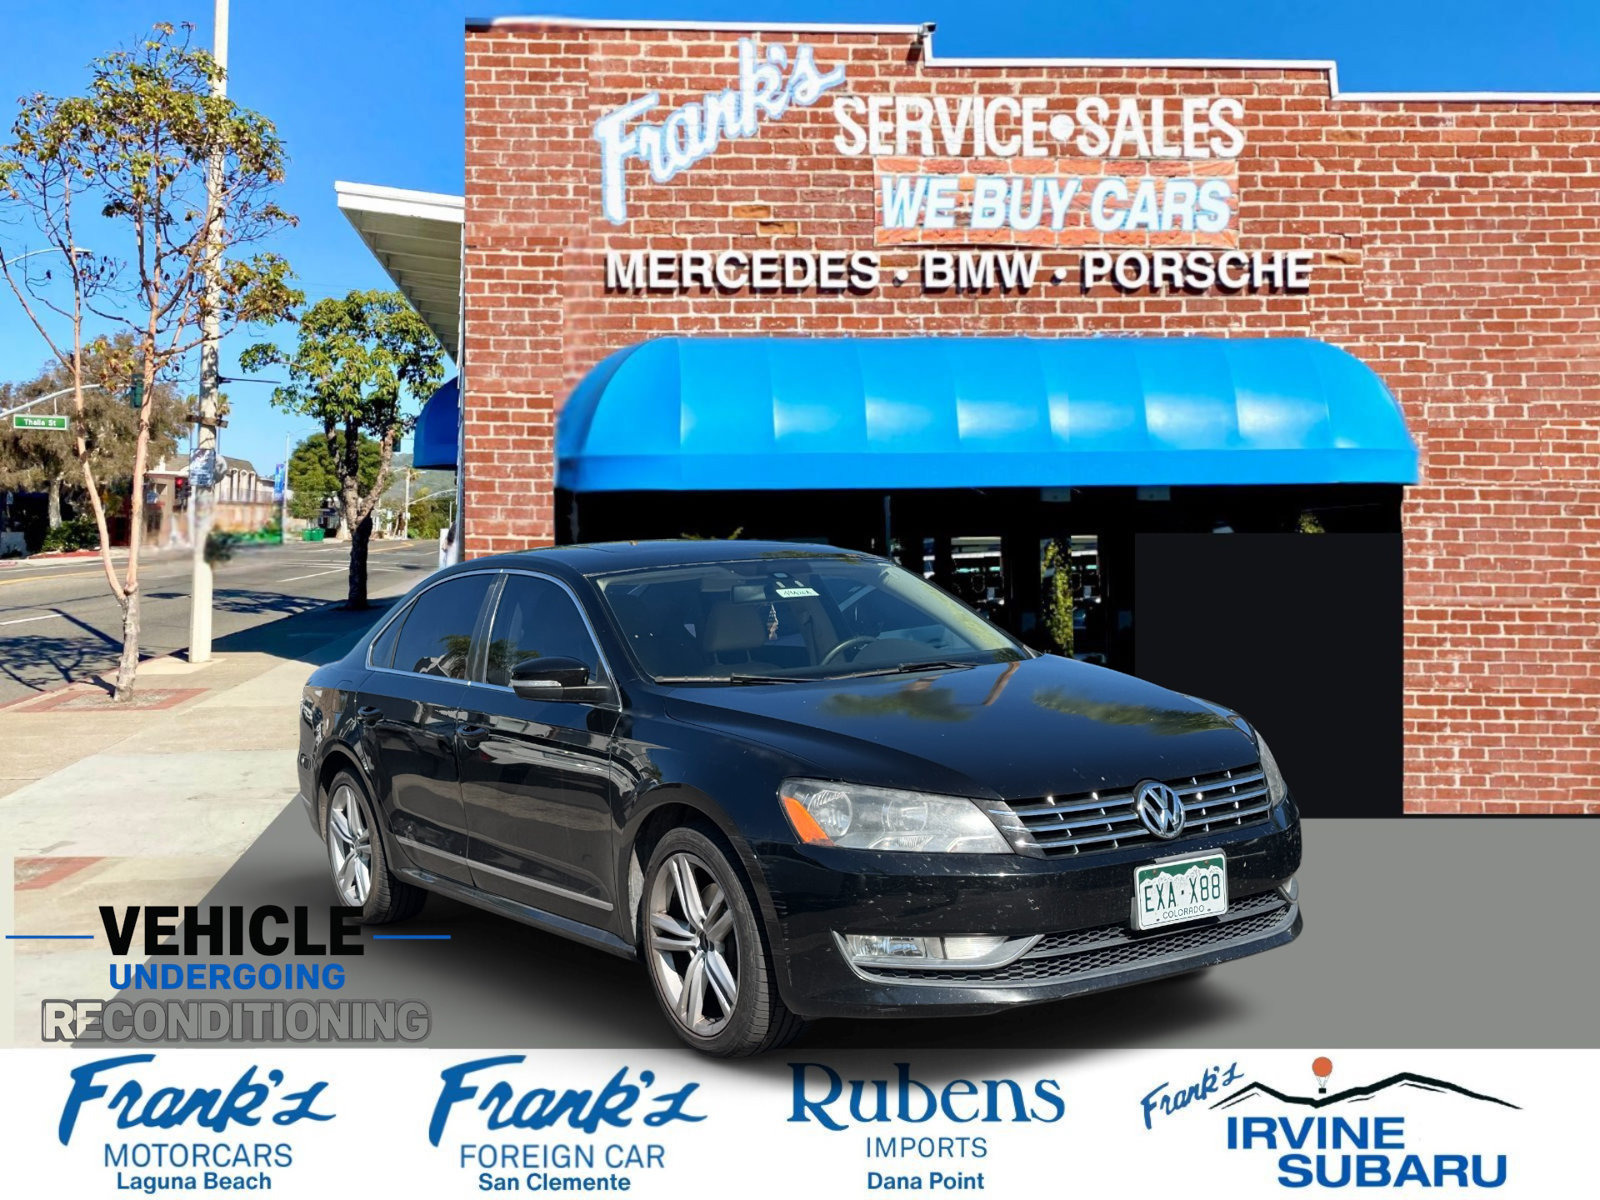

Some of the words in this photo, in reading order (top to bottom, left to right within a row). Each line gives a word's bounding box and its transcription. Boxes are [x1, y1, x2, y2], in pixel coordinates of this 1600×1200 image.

[593, 37, 846, 226] Frank's
[833, 95, 1047, 156] SERVICE
[1075, 97, 1245, 158] SALES
[880, 175, 959, 229] WE
[969, 176, 1080, 231] BUY
[1089, 179, 1233, 232] CARS
[606, 250, 880, 289] MERCEDES
[922, 251, 1040, 291] BMW
[1082, 251, 1314, 292] PORSCHE
[48, 419, 57, 427] St
[1162, 904, 1205, 919] COLORADO
